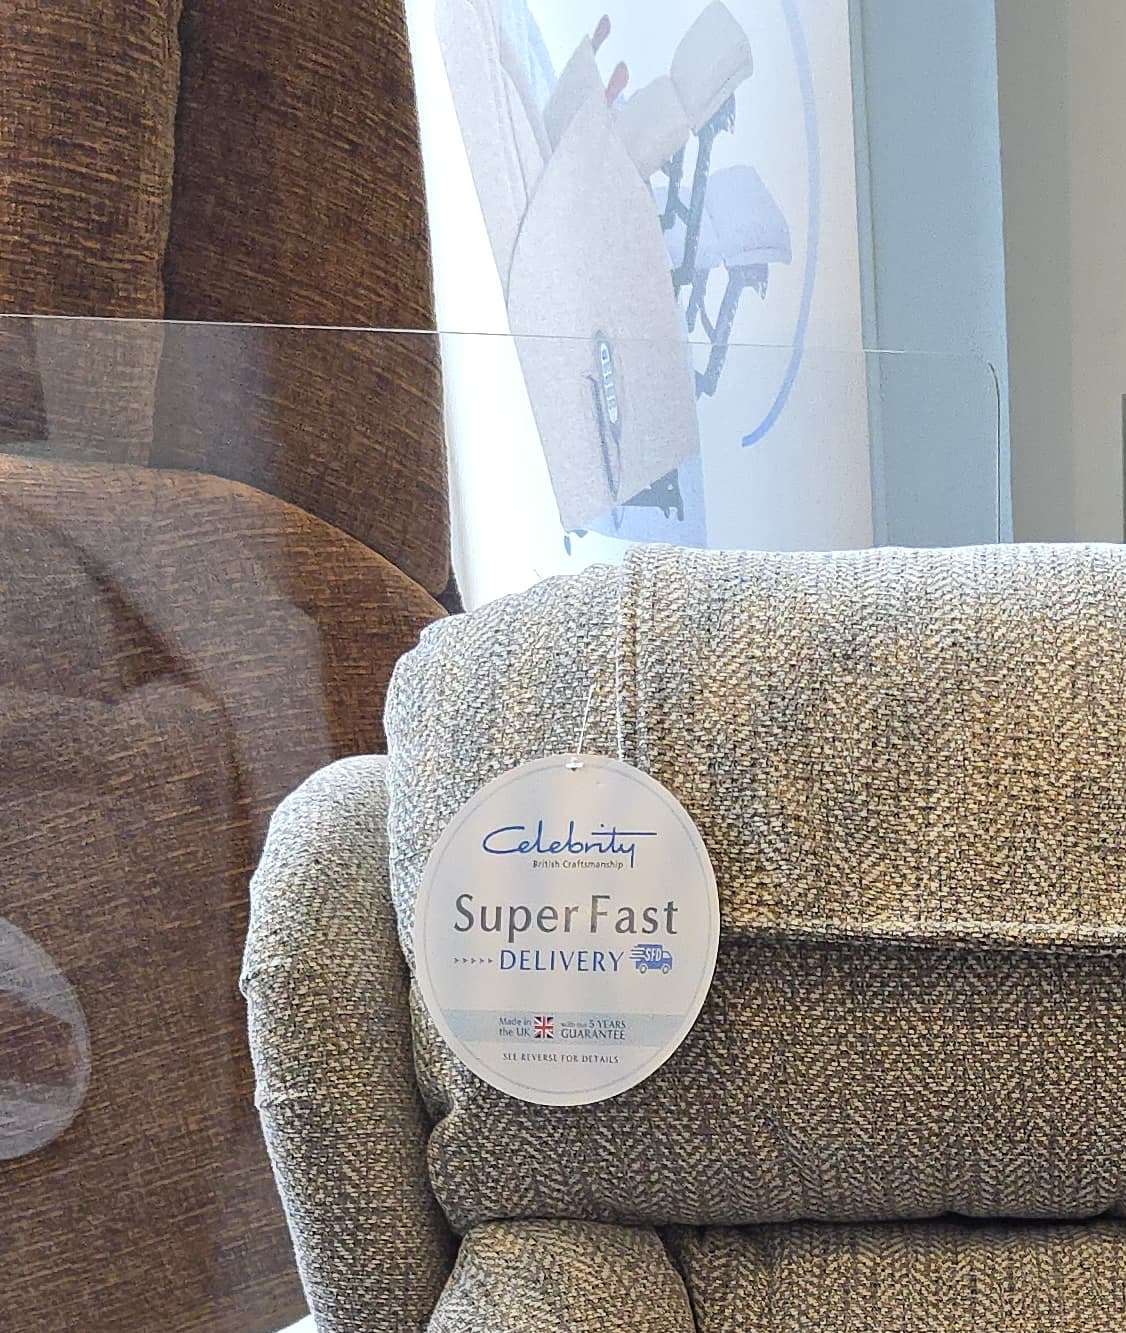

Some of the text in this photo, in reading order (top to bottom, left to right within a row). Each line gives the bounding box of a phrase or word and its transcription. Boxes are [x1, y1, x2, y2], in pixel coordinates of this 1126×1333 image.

[482, 820, 657, 869] Celebrity
[533, 860, 624, 871] British Craftsmanship
[453, 893, 679, 943] Super Fast
[500, 947, 662, 972] DELIVERY SFD
[499, 1017, 532, 1026] Made in
[589, 1020, 595, 1028] 5
[598, 1020, 626, 1029] YEARS
[500, 1028, 531, 1037] the UK
[561, 1029, 625, 1040] GUARANTEE
[521, 1053, 557, 1061] REVERSE
[561, 1054, 578, 1062] FOR
[582, 1055, 619, 1064] DETAILS
